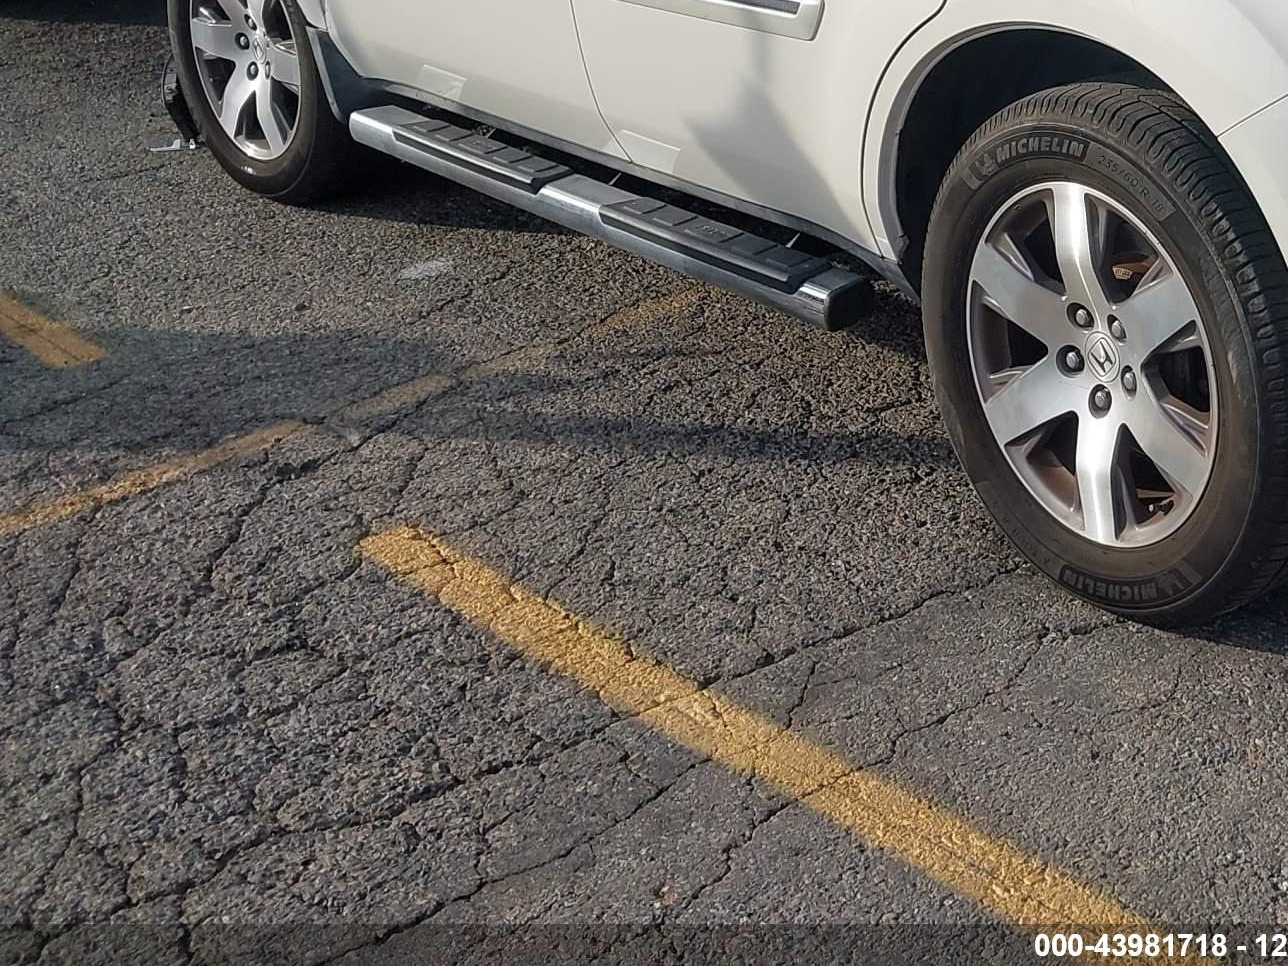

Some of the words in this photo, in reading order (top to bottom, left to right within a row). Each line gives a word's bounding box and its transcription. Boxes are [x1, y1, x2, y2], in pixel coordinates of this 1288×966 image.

[996, 137, 1085, 163] MICHELIN
[1097, 155, 1139, 187] 235/60
[1062, 569, 1158, 601] MICHELIN
